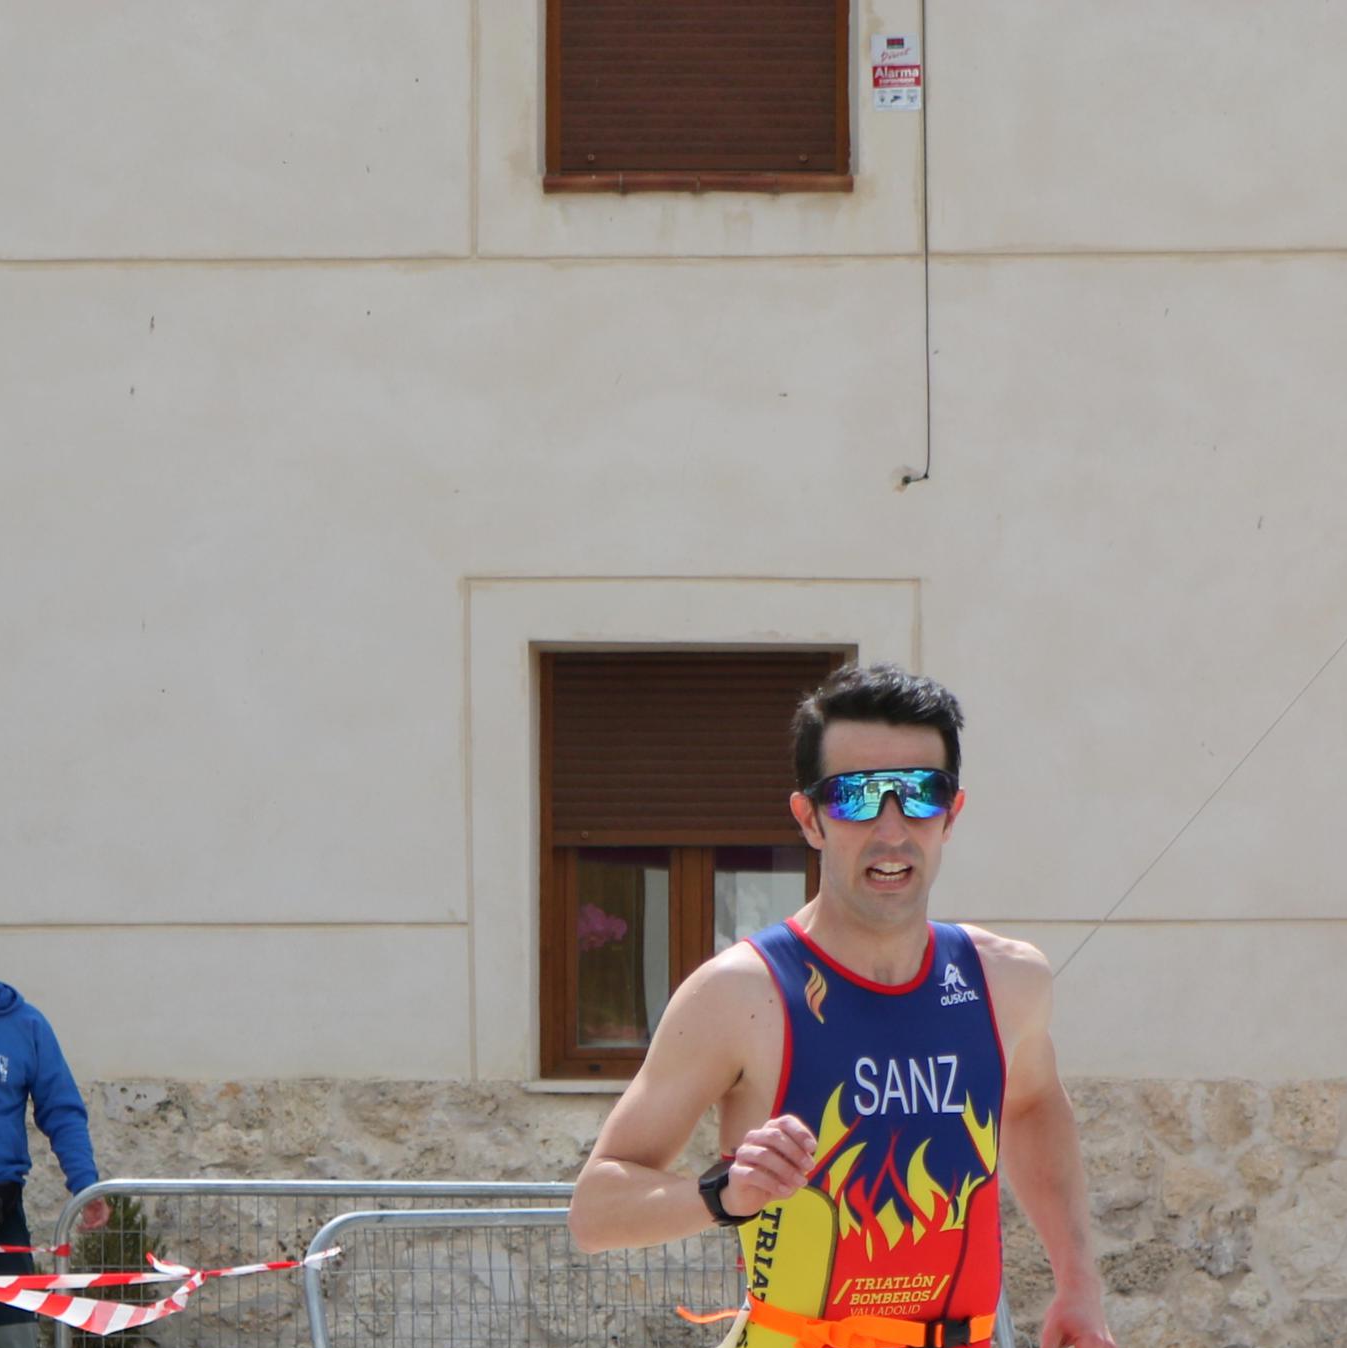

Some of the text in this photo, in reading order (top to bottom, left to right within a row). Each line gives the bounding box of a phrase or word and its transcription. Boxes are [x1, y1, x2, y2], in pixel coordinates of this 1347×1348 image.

[854, 1055, 964, 1116] SANZ
[855, 1273, 935, 1290] TRIATLÓN
[850, 1291, 931, 1305] BOMBEROS
[851, 1305, 920, 1317] VALLADOLID
